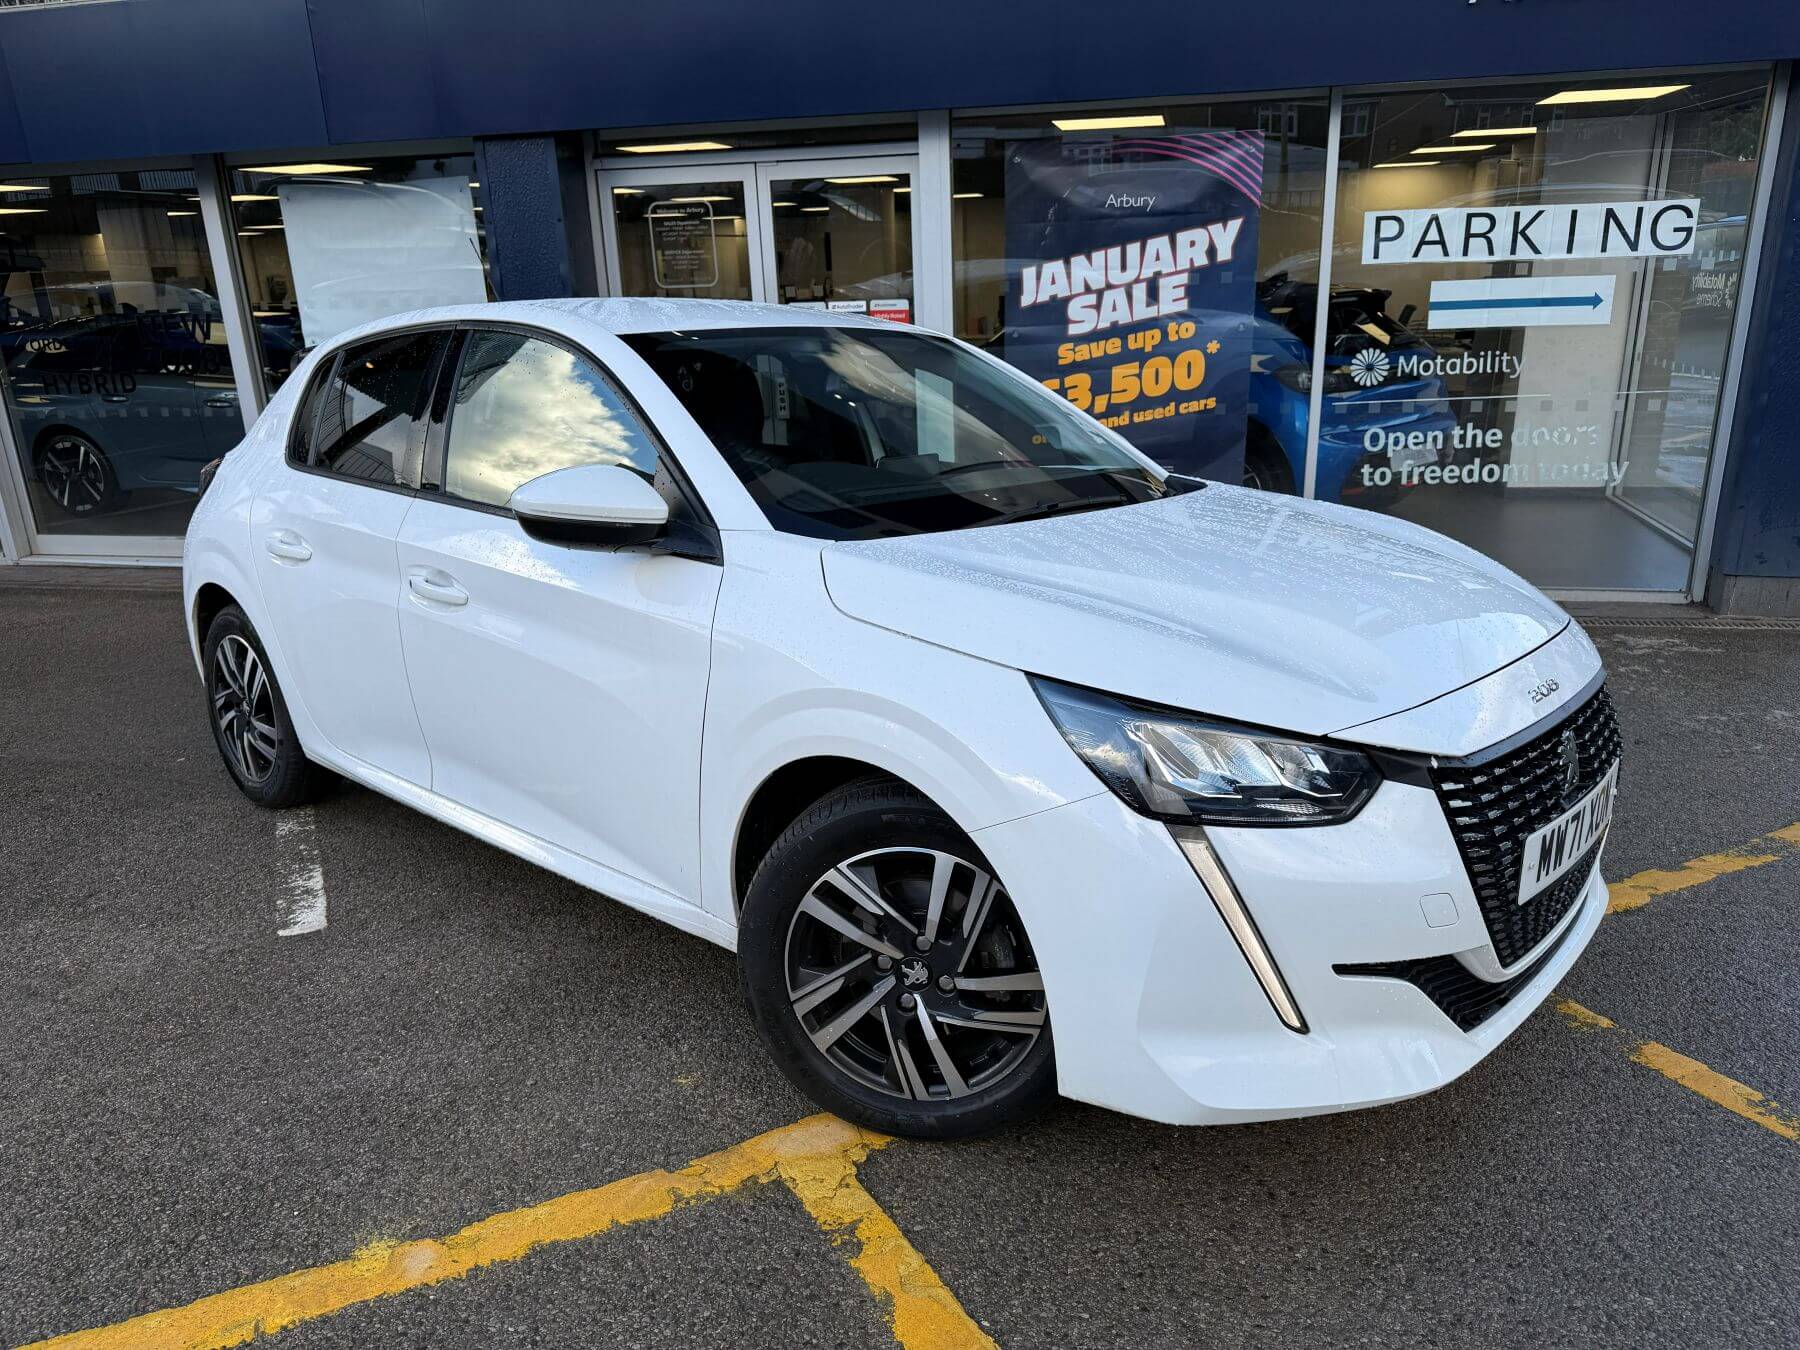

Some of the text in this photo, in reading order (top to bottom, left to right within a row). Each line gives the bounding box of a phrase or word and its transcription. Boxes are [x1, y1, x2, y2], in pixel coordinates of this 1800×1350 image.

[1105, 194, 1156, 212] Arbury
[1373, 204, 1694, 259] PARKING
[1021, 217, 1244, 307] JANUARY
[1067, 272, 1189, 335] SALE
[1057, 321, 1196, 366] Save up to
[1397, 350, 1525, 379] Motability
[43, 373, 137, 395] HYBRID
[778, 382, 787, 412] PUSH
[1133, 402, 1176, 422] used
[1179, 396, 1217, 415] cars
[1363, 422, 1599, 457] Open the doors
[1361, 456, 1630, 487] to freedom today
[1527, 677, 1561, 704] 208
[1536, 805, 1587, 883] MW71
